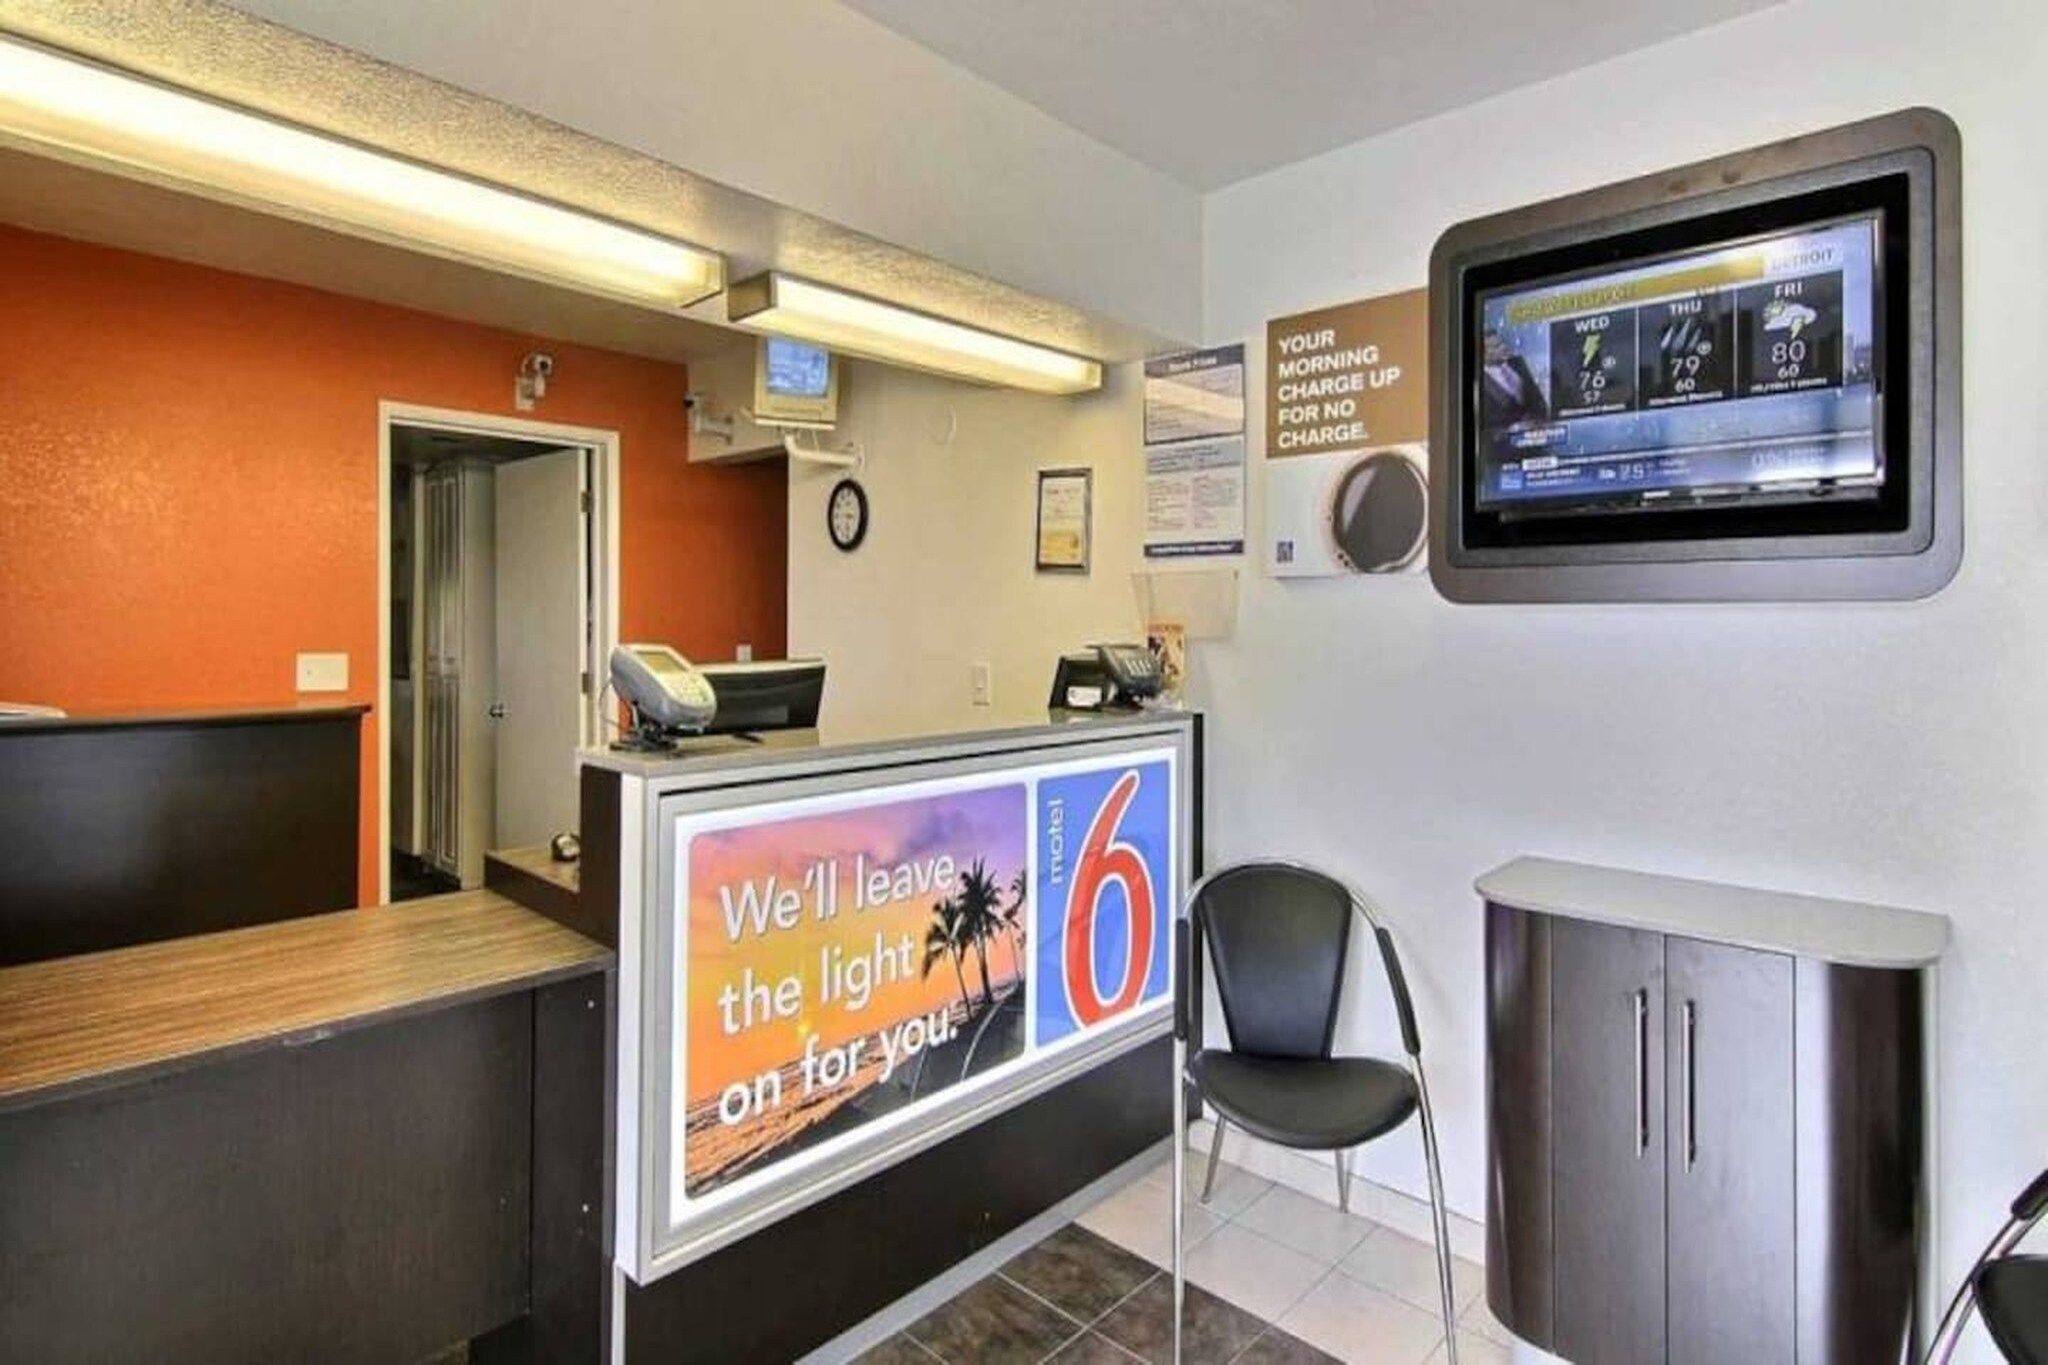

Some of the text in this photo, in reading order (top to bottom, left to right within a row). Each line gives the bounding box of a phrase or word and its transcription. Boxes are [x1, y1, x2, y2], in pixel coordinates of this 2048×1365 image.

[1774, 281, 1803, 298] FRI
[1669, 299, 1703, 316] THU
[1575, 315, 1610, 333] WED
[1278, 329, 1336, 355] YOUR
[1771, 339, 1806, 364] 80
[1278, 344, 1380, 378] MORNING
[1669, 354, 1701, 378] 79
[1777, 363, 1801, 379] 60
[1277, 365, 1401, 402] CHARGE UP
[1578, 369, 1606, 392] 76
[1674, 377, 1696, 393] 60
[1278, 398, 1356, 425] FOR NO
[1277, 421, 1369, 448] CHARGE.
[718, 853, 956, 941] We'll leave
[1048, 768, 1156, 1032] motel 6
[718, 930, 916, 1036] the light
[717, 1008, 959, 1127] on for you.
